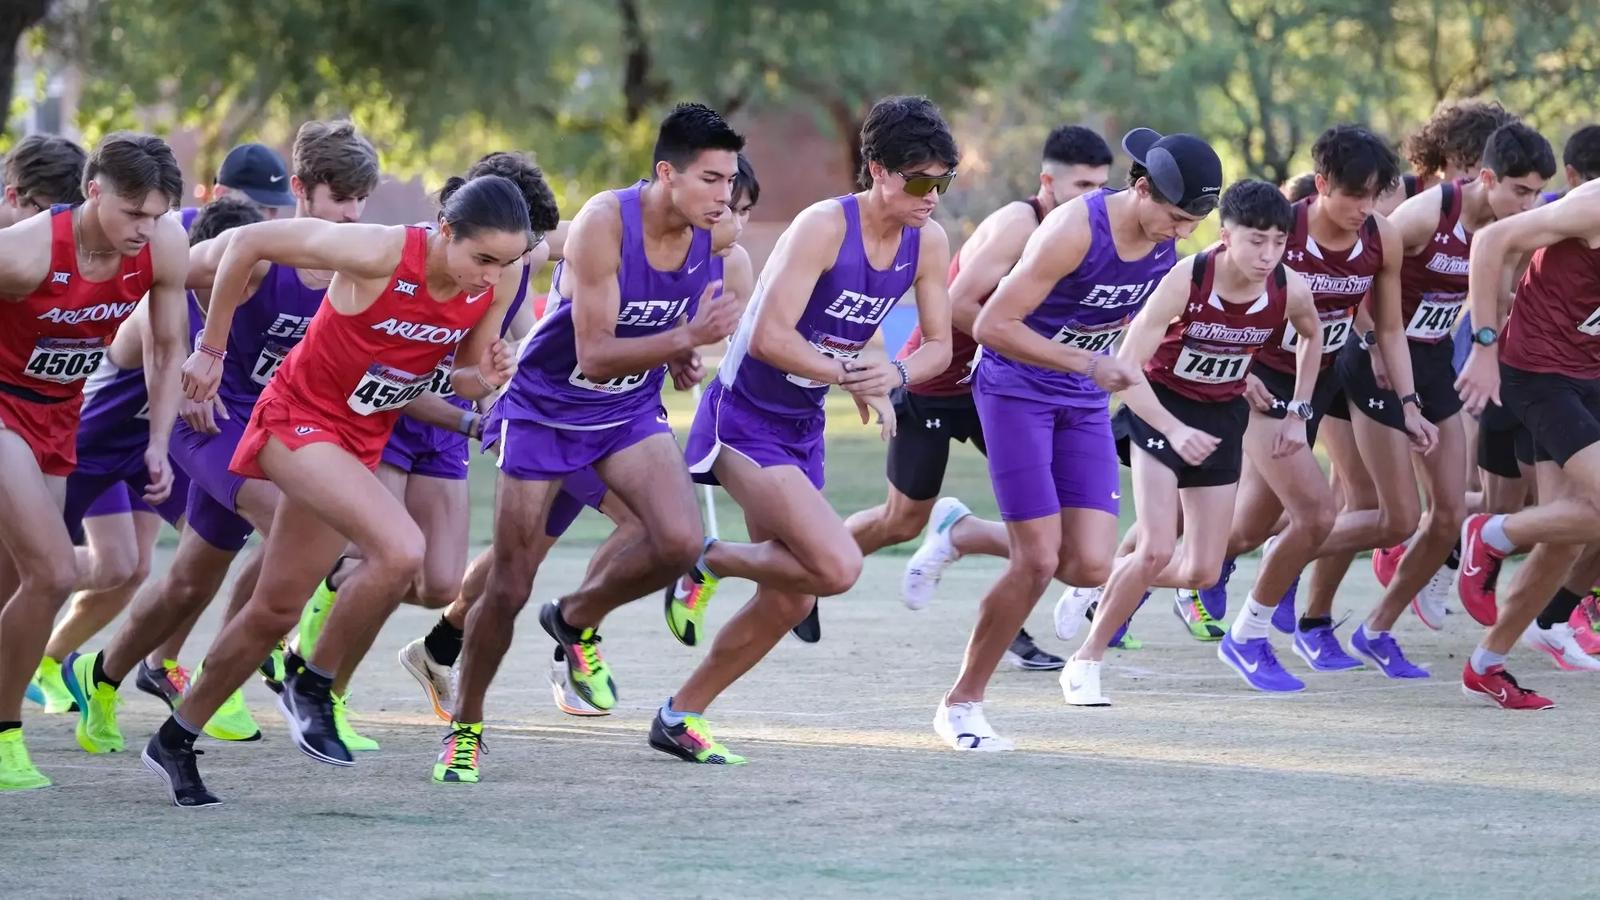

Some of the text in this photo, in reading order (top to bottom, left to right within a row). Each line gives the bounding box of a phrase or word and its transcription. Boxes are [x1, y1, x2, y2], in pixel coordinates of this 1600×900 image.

[824, 289, 896, 325] GCU
[1079, 279, 1154, 309] GCU
[616, 296, 690, 326] GCU
[370, 317, 471, 345] ARIZON
[1060, 329, 1123, 352] 7387
[27, 352, 104, 376] 4503
[1184, 353, 1244, 378] 7411
[354, 379, 431, 408] 4506
